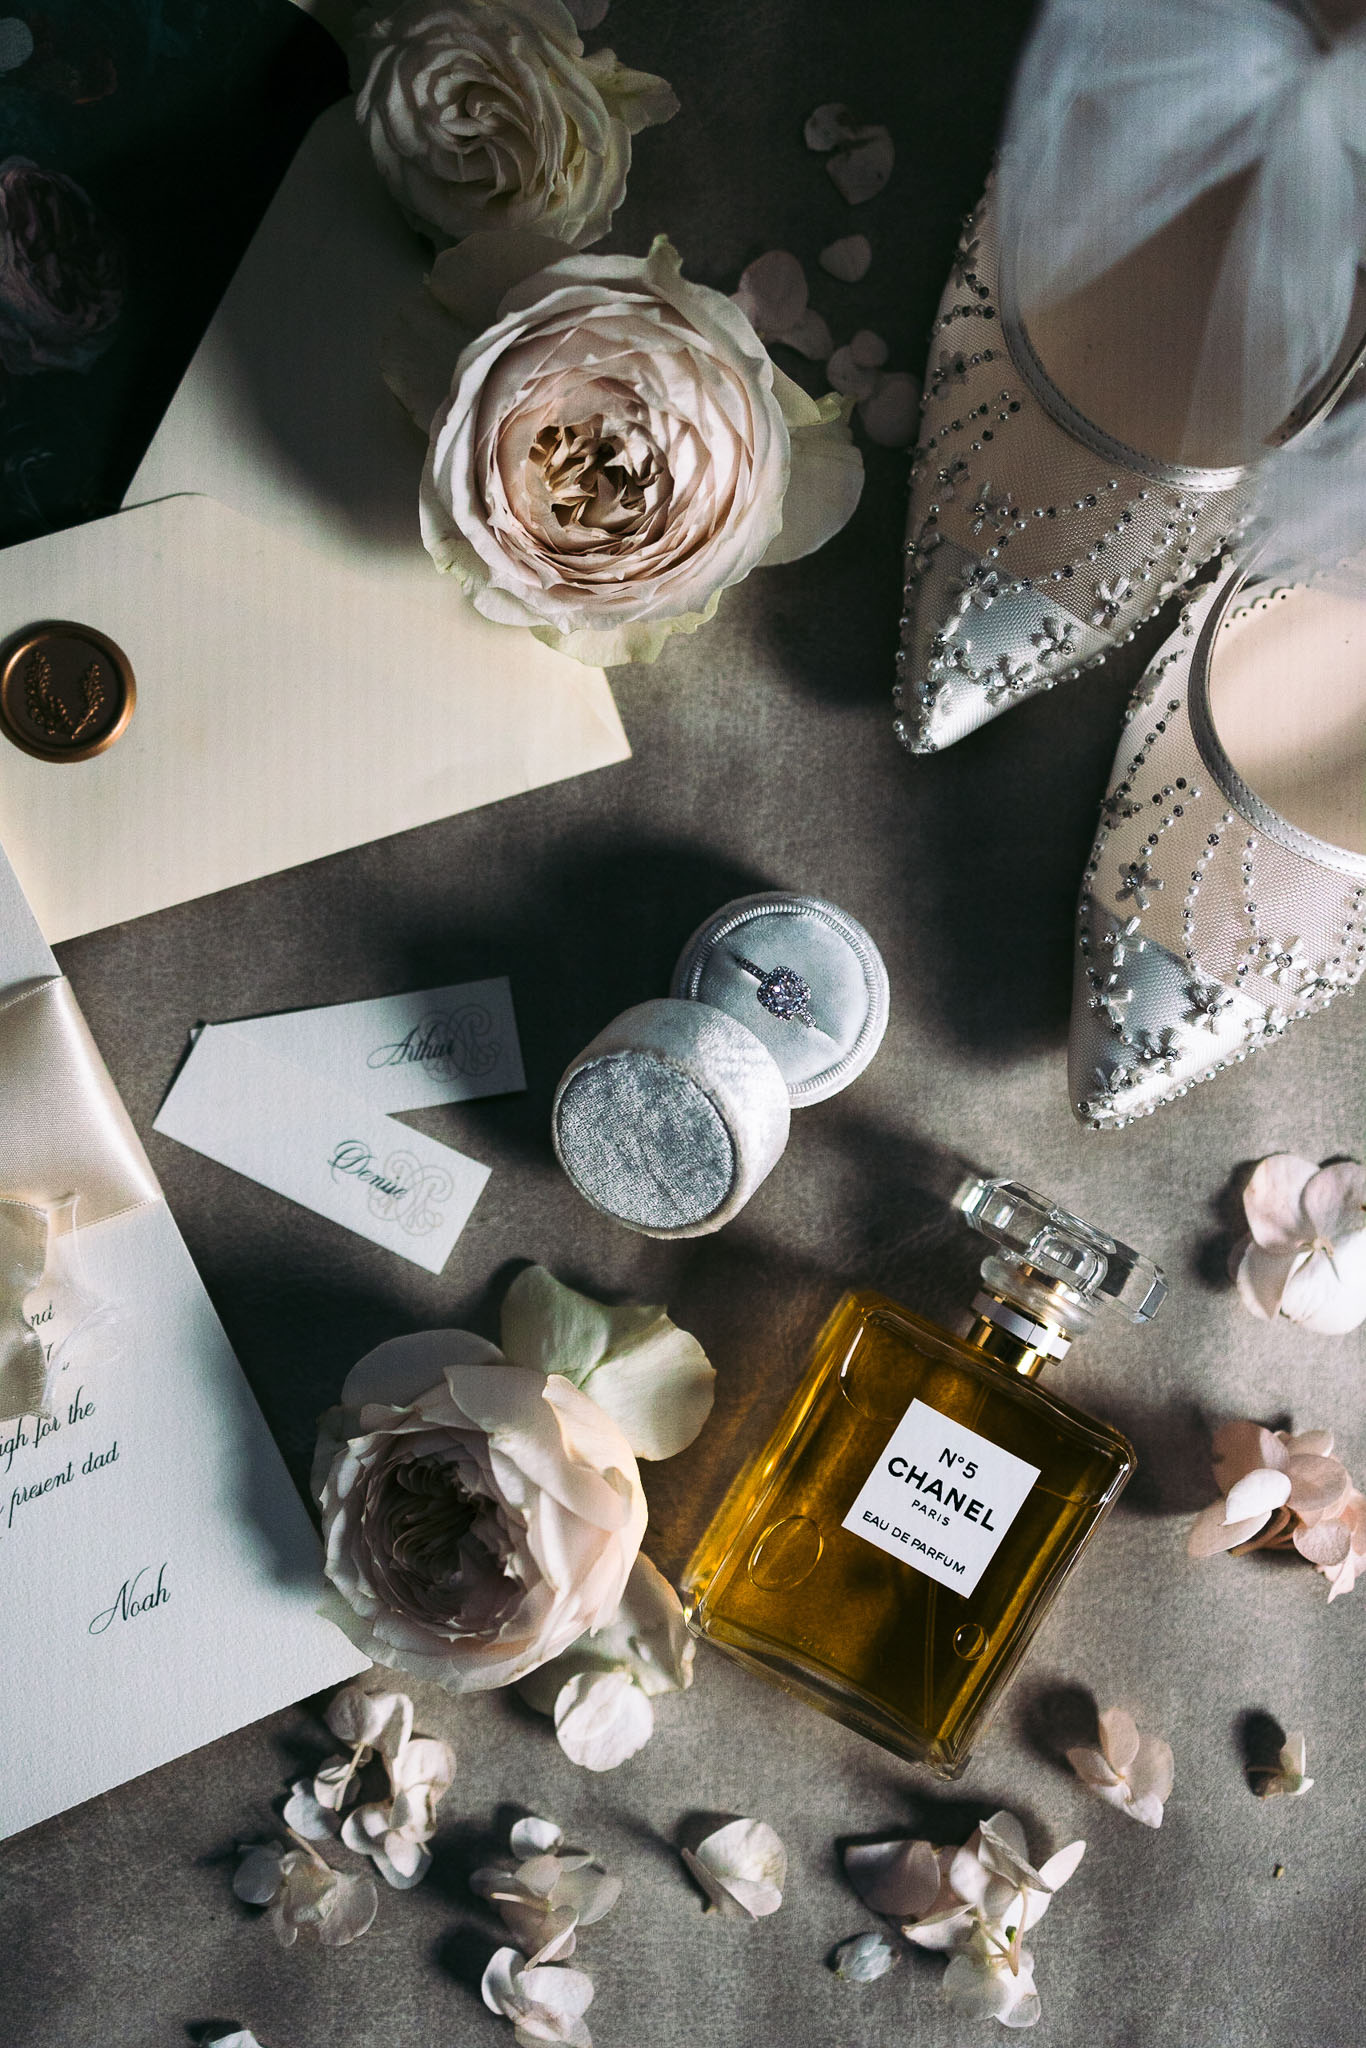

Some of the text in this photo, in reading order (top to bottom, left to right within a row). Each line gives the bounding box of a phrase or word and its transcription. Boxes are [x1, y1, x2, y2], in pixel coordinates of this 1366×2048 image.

[367, 1022, 456, 1069] Arthur
[328, 1139, 408, 1200] Denise
[0, 1385, 96, 1474] igh for the
[8, 1441, 120, 1529] present dad
[887, 1456, 995, 1532] CHANEL
[911, 1499, 951, 1527] PARIS
[862, 1510, 966, 1575] EAU DE PARFUM
[88, 1561, 171, 1635] Noah
